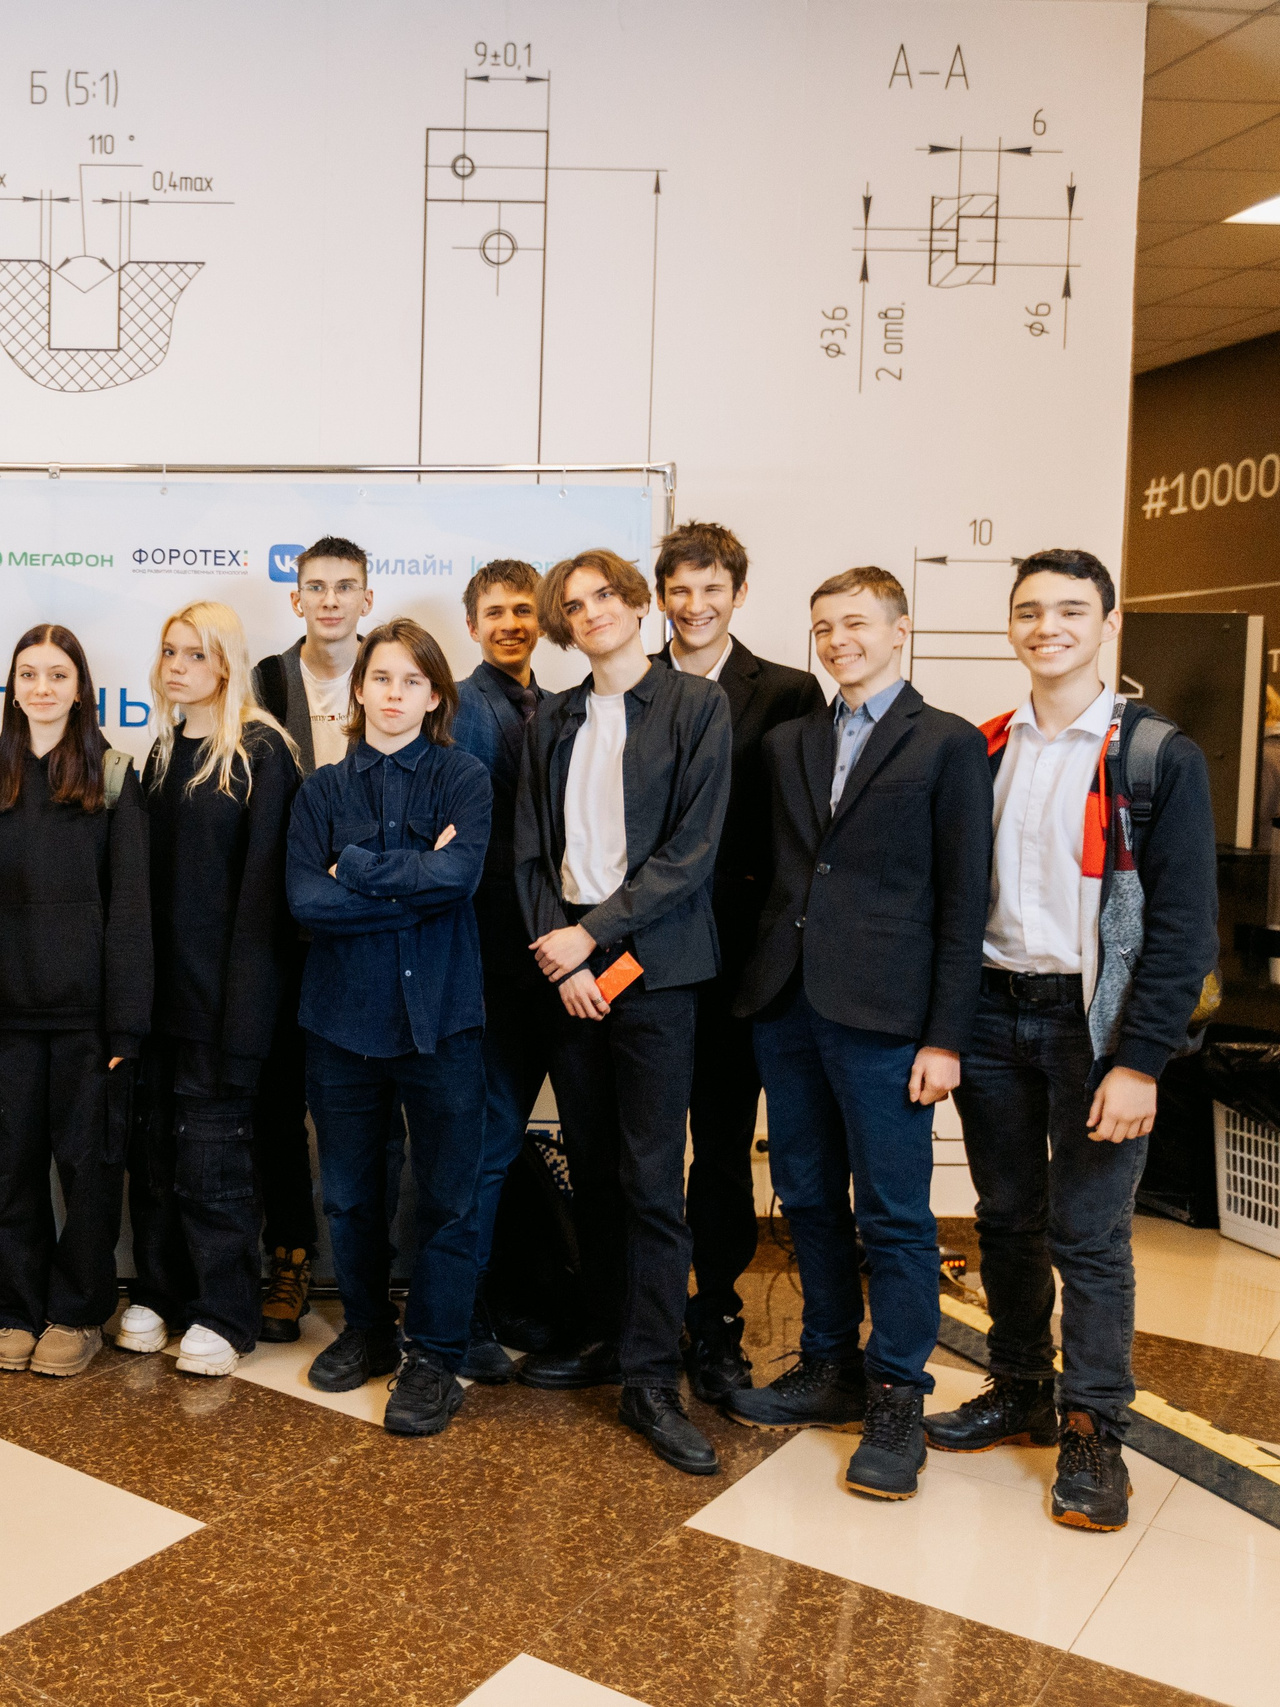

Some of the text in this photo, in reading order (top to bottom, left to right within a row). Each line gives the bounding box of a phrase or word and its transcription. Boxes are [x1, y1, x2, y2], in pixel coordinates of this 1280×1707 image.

[30, 69, 119, 107] Б (5:1)
[1032, 108, 1046, 136] 6
[152, 170, 214, 194] 0,4max
[875, 367, 903, 382] 2
[969, 519, 993, 546] 10
